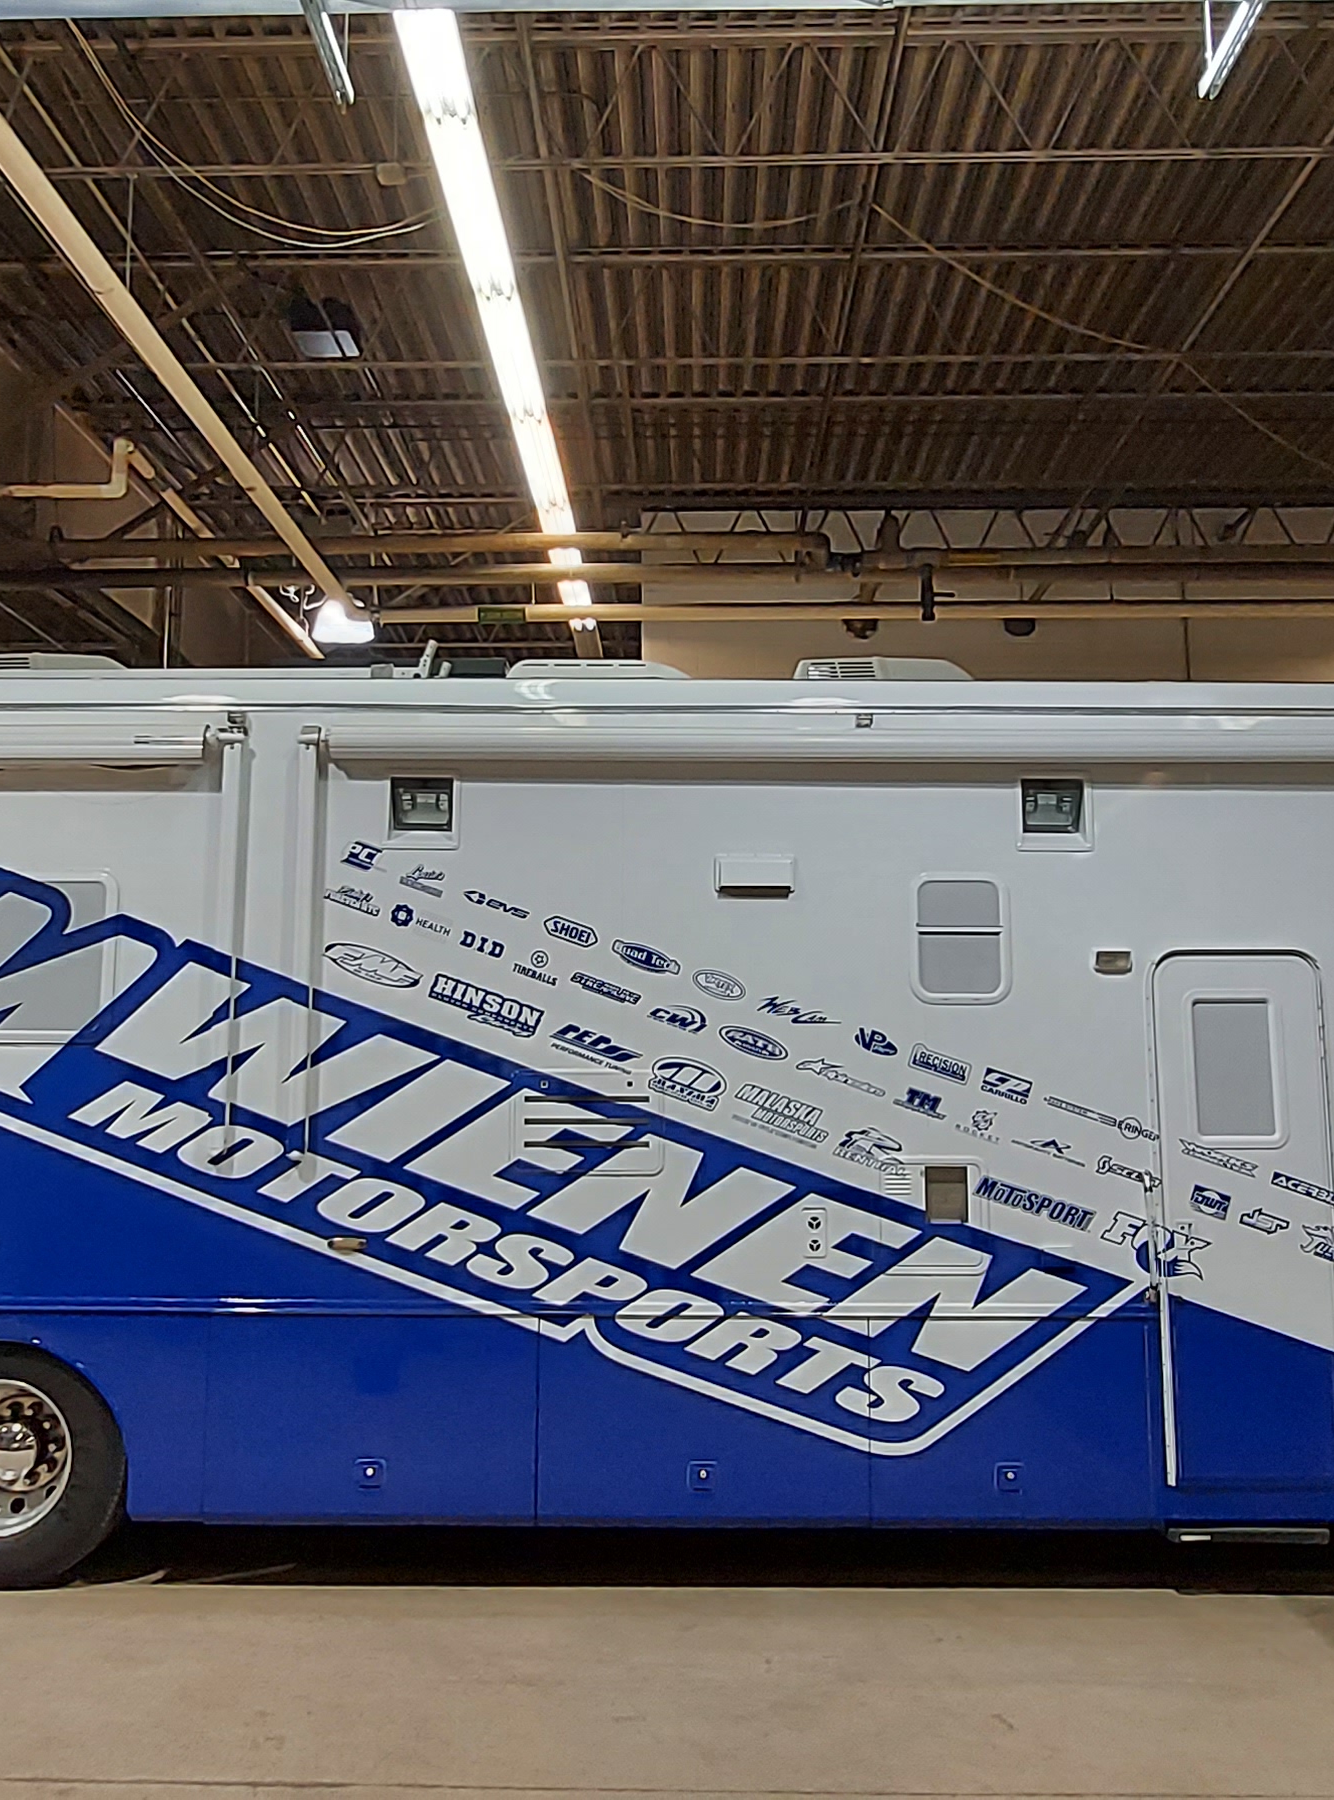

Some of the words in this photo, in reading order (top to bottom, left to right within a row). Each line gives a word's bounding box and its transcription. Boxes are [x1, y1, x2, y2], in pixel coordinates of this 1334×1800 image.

[416, 917, 451, 937] HEALTH
[551, 920, 591, 944] SHOEI
[512, 962, 558, 986] TIREBALLS
[433, 976, 542, 1026] HINSON
[858, 1028, 887, 1051] VP
[551, 1043, 604, 1067] PERFORMANCE
[736, 1085, 822, 1125] MALASKA
[980, 1083, 1028, 1105] CARRILLO
[753, 1107, 828, 1142] MOTORSPORTS
[955, 1124, 1000, 1144] ROCKET
[95, 961, 1087, 1373] WIENEN
[68, 1082, 945, 1424] MOTORSPORTS
[1100, 1210, 1213, 1281] FOX
